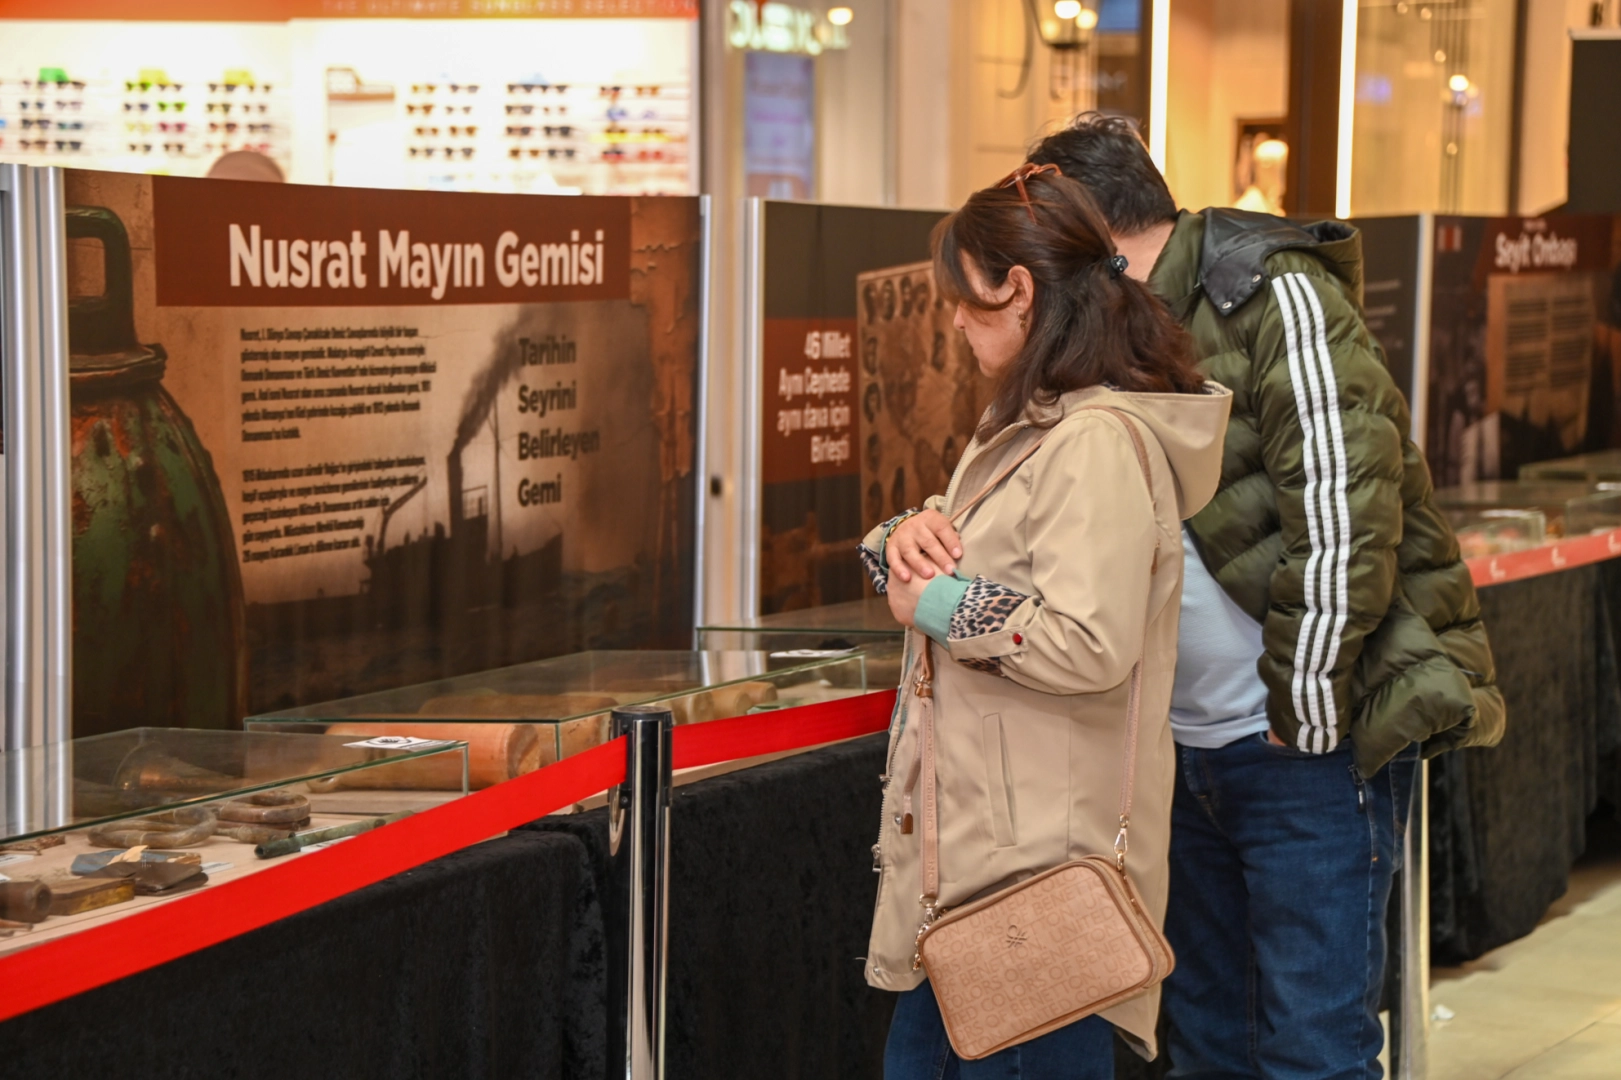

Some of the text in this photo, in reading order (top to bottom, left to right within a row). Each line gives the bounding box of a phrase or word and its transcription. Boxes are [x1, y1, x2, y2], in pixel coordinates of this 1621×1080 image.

[229, 223, 605, 299] Nusrat Mayın Gemisi
[518, 336, 576, 366] Tarihin
[518, 384, 576, 417] Seyrini
[518, 427, 600, 461] Belirleyen
[518, 474, 562, 507] Gemi
[938, 919, 1004, 959] COLORS
[1049, 903, 1116, 944] UNITED
[961, 945, 987, 967] OF
[1002, 961, 1028, 984] OF
[979, 971, 1047, 1013] COLORS
[1047, 959, 1073, 982] OF
[983, 1008, 1009, 1029] OF
